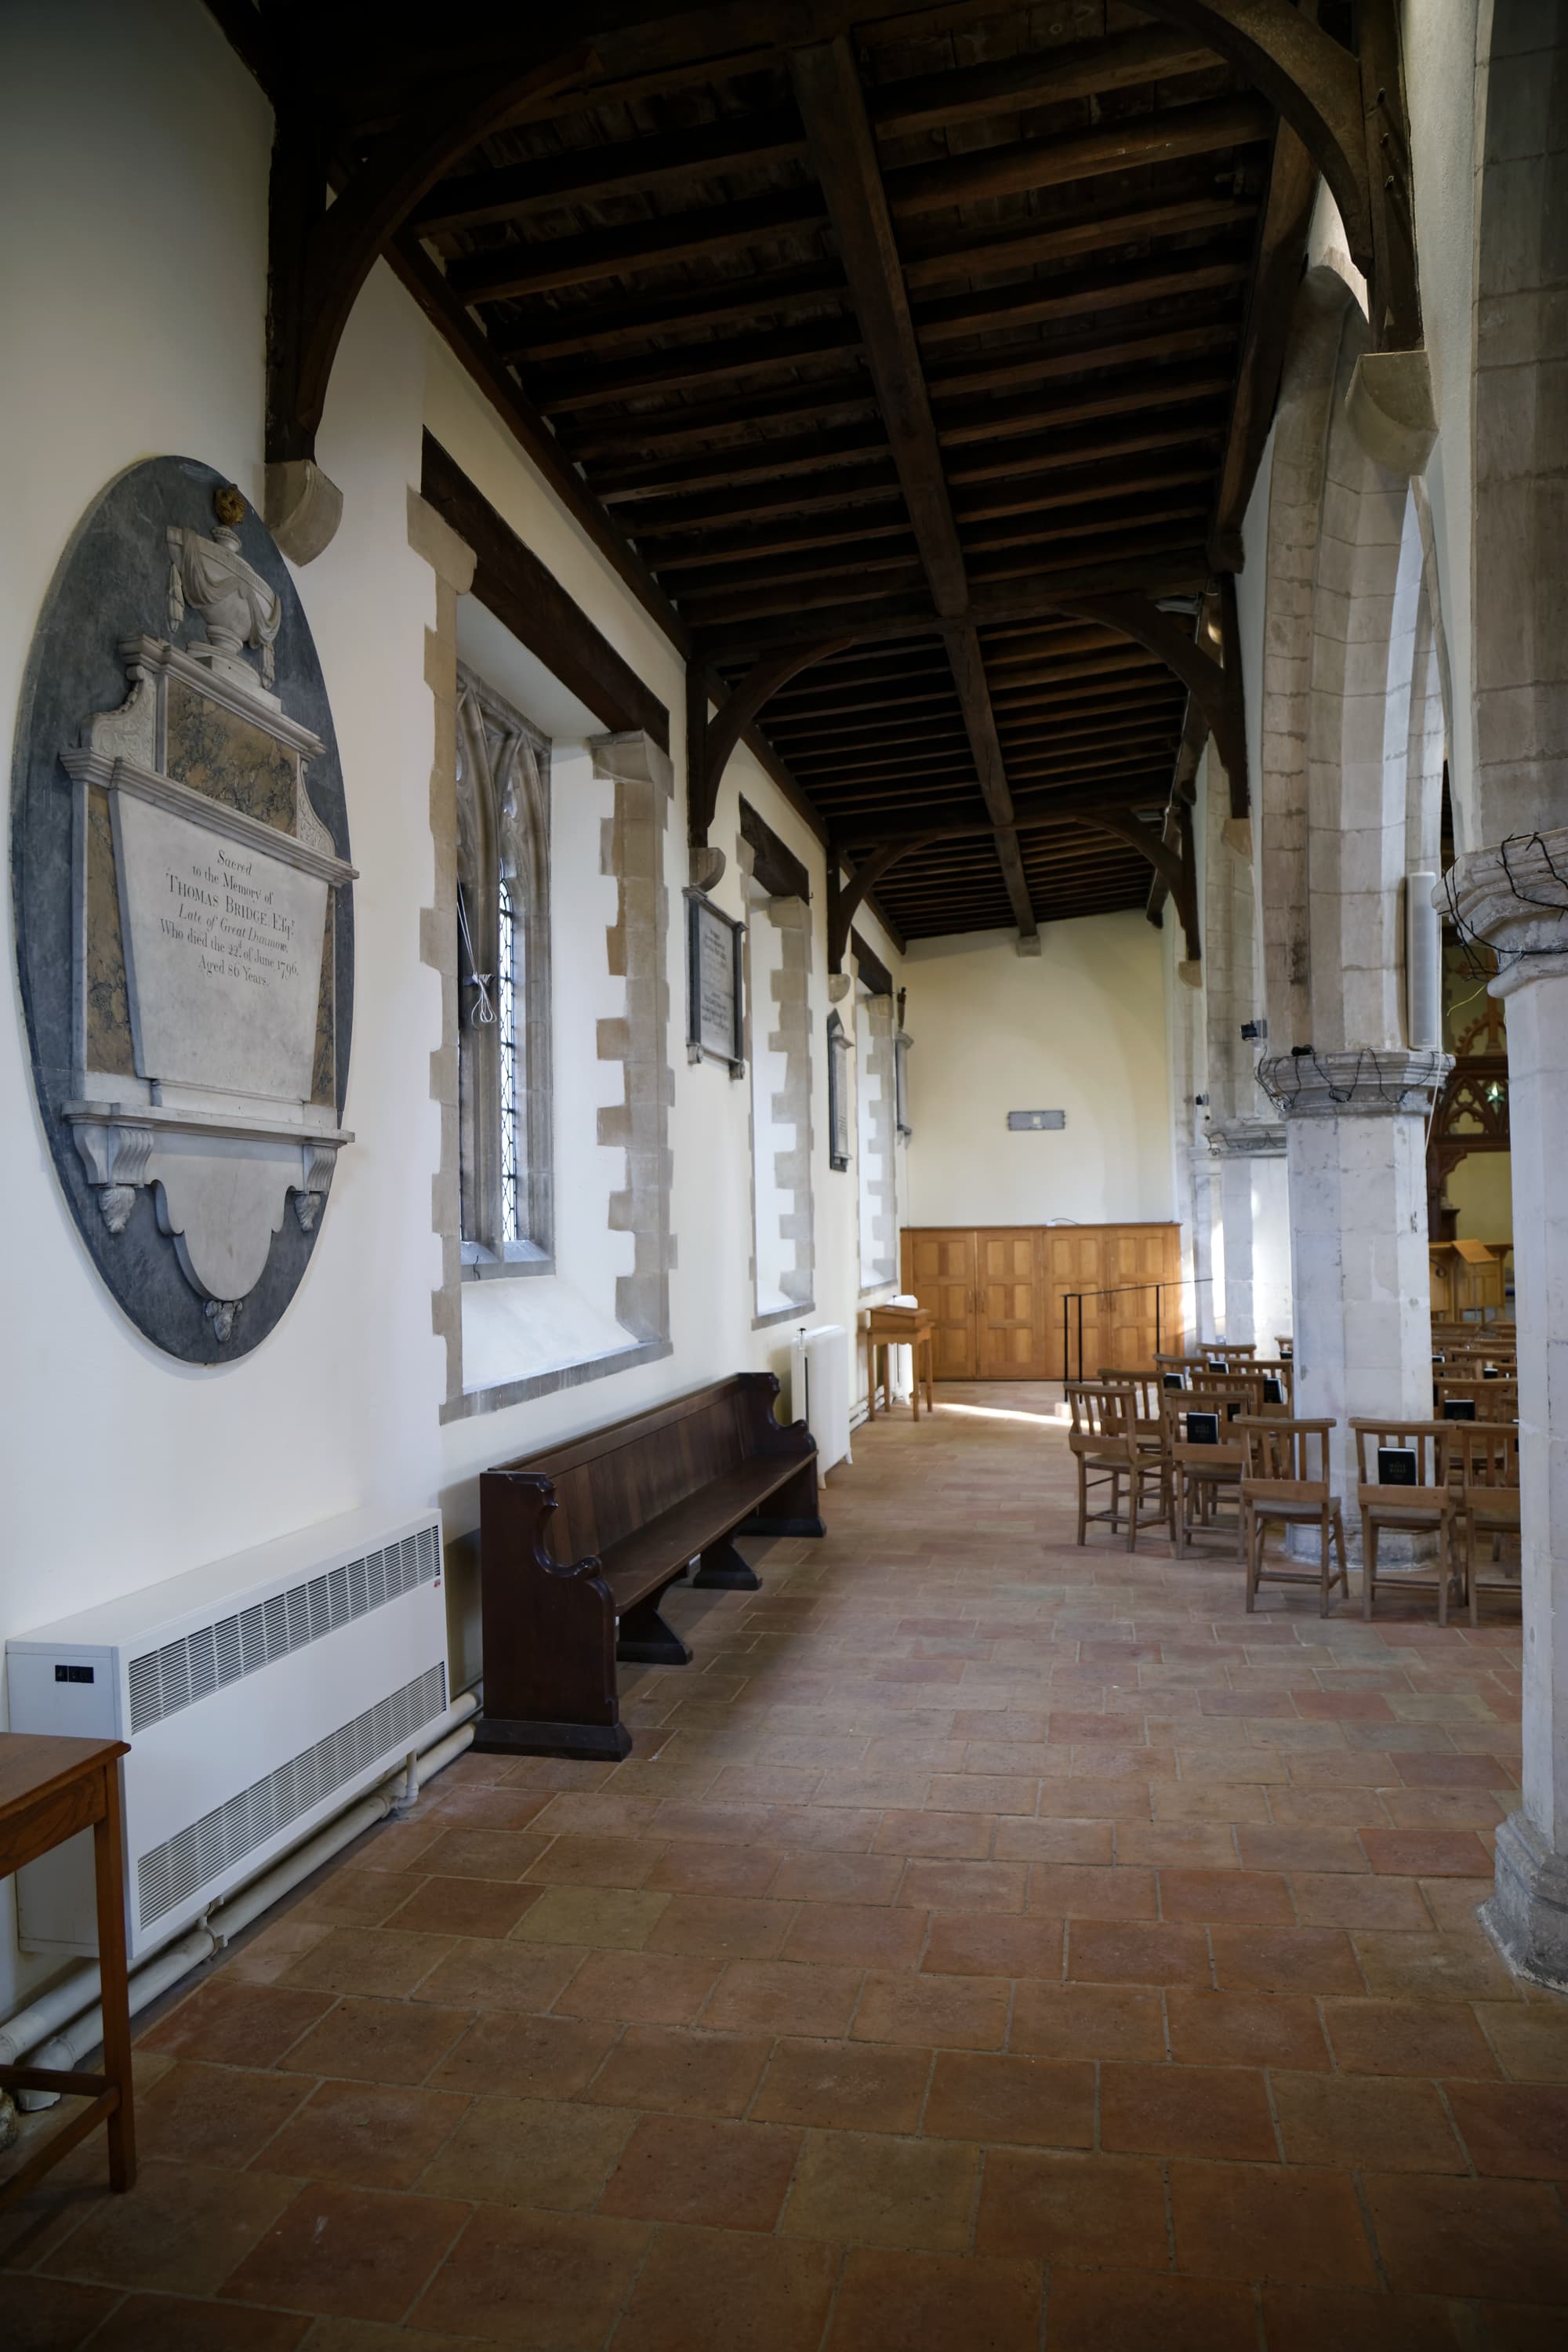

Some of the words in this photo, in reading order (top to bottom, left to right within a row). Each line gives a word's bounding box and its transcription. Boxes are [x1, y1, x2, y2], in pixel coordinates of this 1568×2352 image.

[217, 850, 252, 876] Sacred
[166, 874, 219, 906] THOMAS
[193, 866, 201, 877] to
[205, 868, 220, 883] the
[223, 873, 261, 903] Memory
[264, 892, 274, 905] of
[179, 904, 202, 924] Late
[207, 916, 218, 931] of
[220, 920, 246, 937] Great
[160, 919, 183, 940] Who
[187, 929, 208, 947] died
[211, 936, 225, 953] the
[244, 946, 253, 960] of
[253, 949, 274, 967] June
[198, 955, 224, 978] Aged
